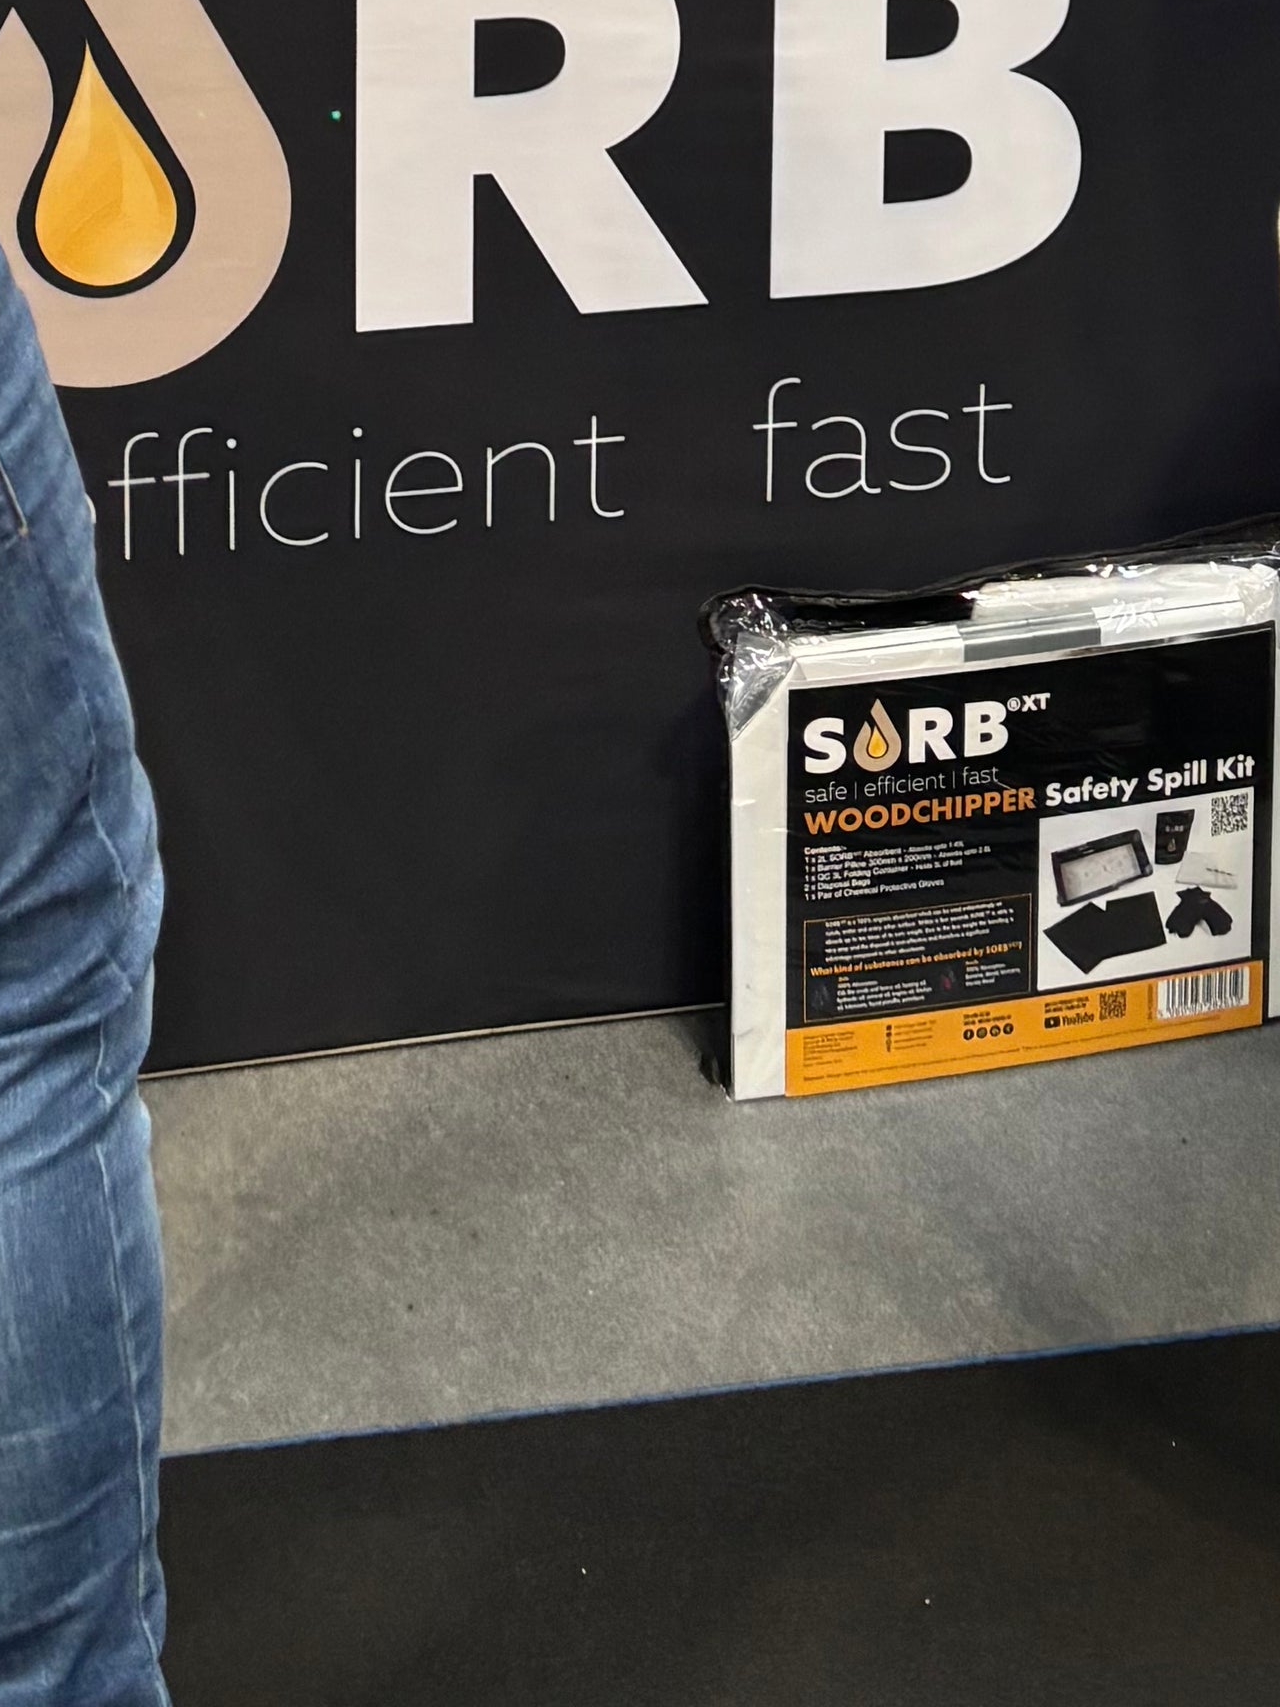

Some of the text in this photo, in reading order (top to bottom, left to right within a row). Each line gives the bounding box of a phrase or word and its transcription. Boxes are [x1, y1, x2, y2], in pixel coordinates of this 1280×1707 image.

[107, 376, 1014, 561] fficient fast
[804, 754, 1256, 835] WOODCHIPPER Safety Spill Kit
[805, 766, 1000, 804] safe efficient fast
